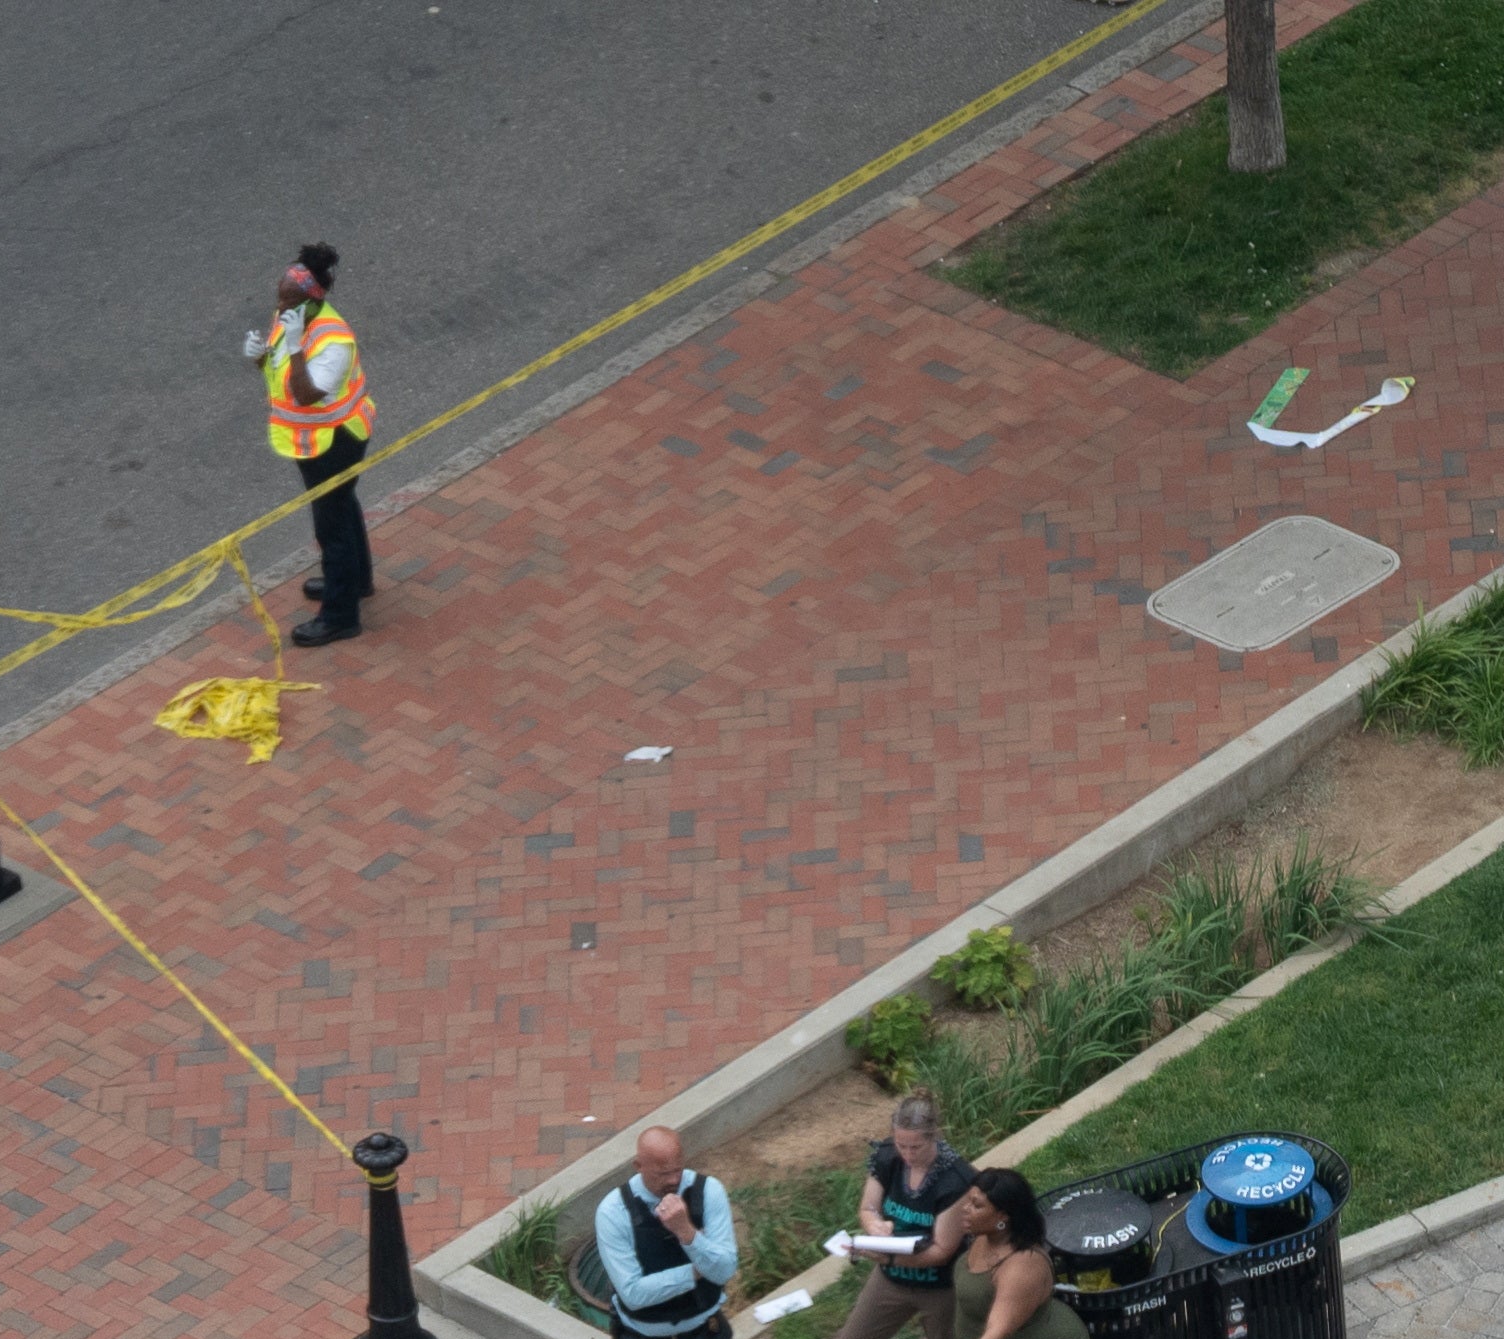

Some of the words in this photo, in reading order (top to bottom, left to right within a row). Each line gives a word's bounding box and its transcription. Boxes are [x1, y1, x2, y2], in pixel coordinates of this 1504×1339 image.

[1237, 1164, 1306, 1198] RECYCLE
[1082, 1223, 1139, 1250] TRASH
[1250, 1253, 1305, 1277] RECYCLE
[1124, 1296, 1167, 1316] TRASH
